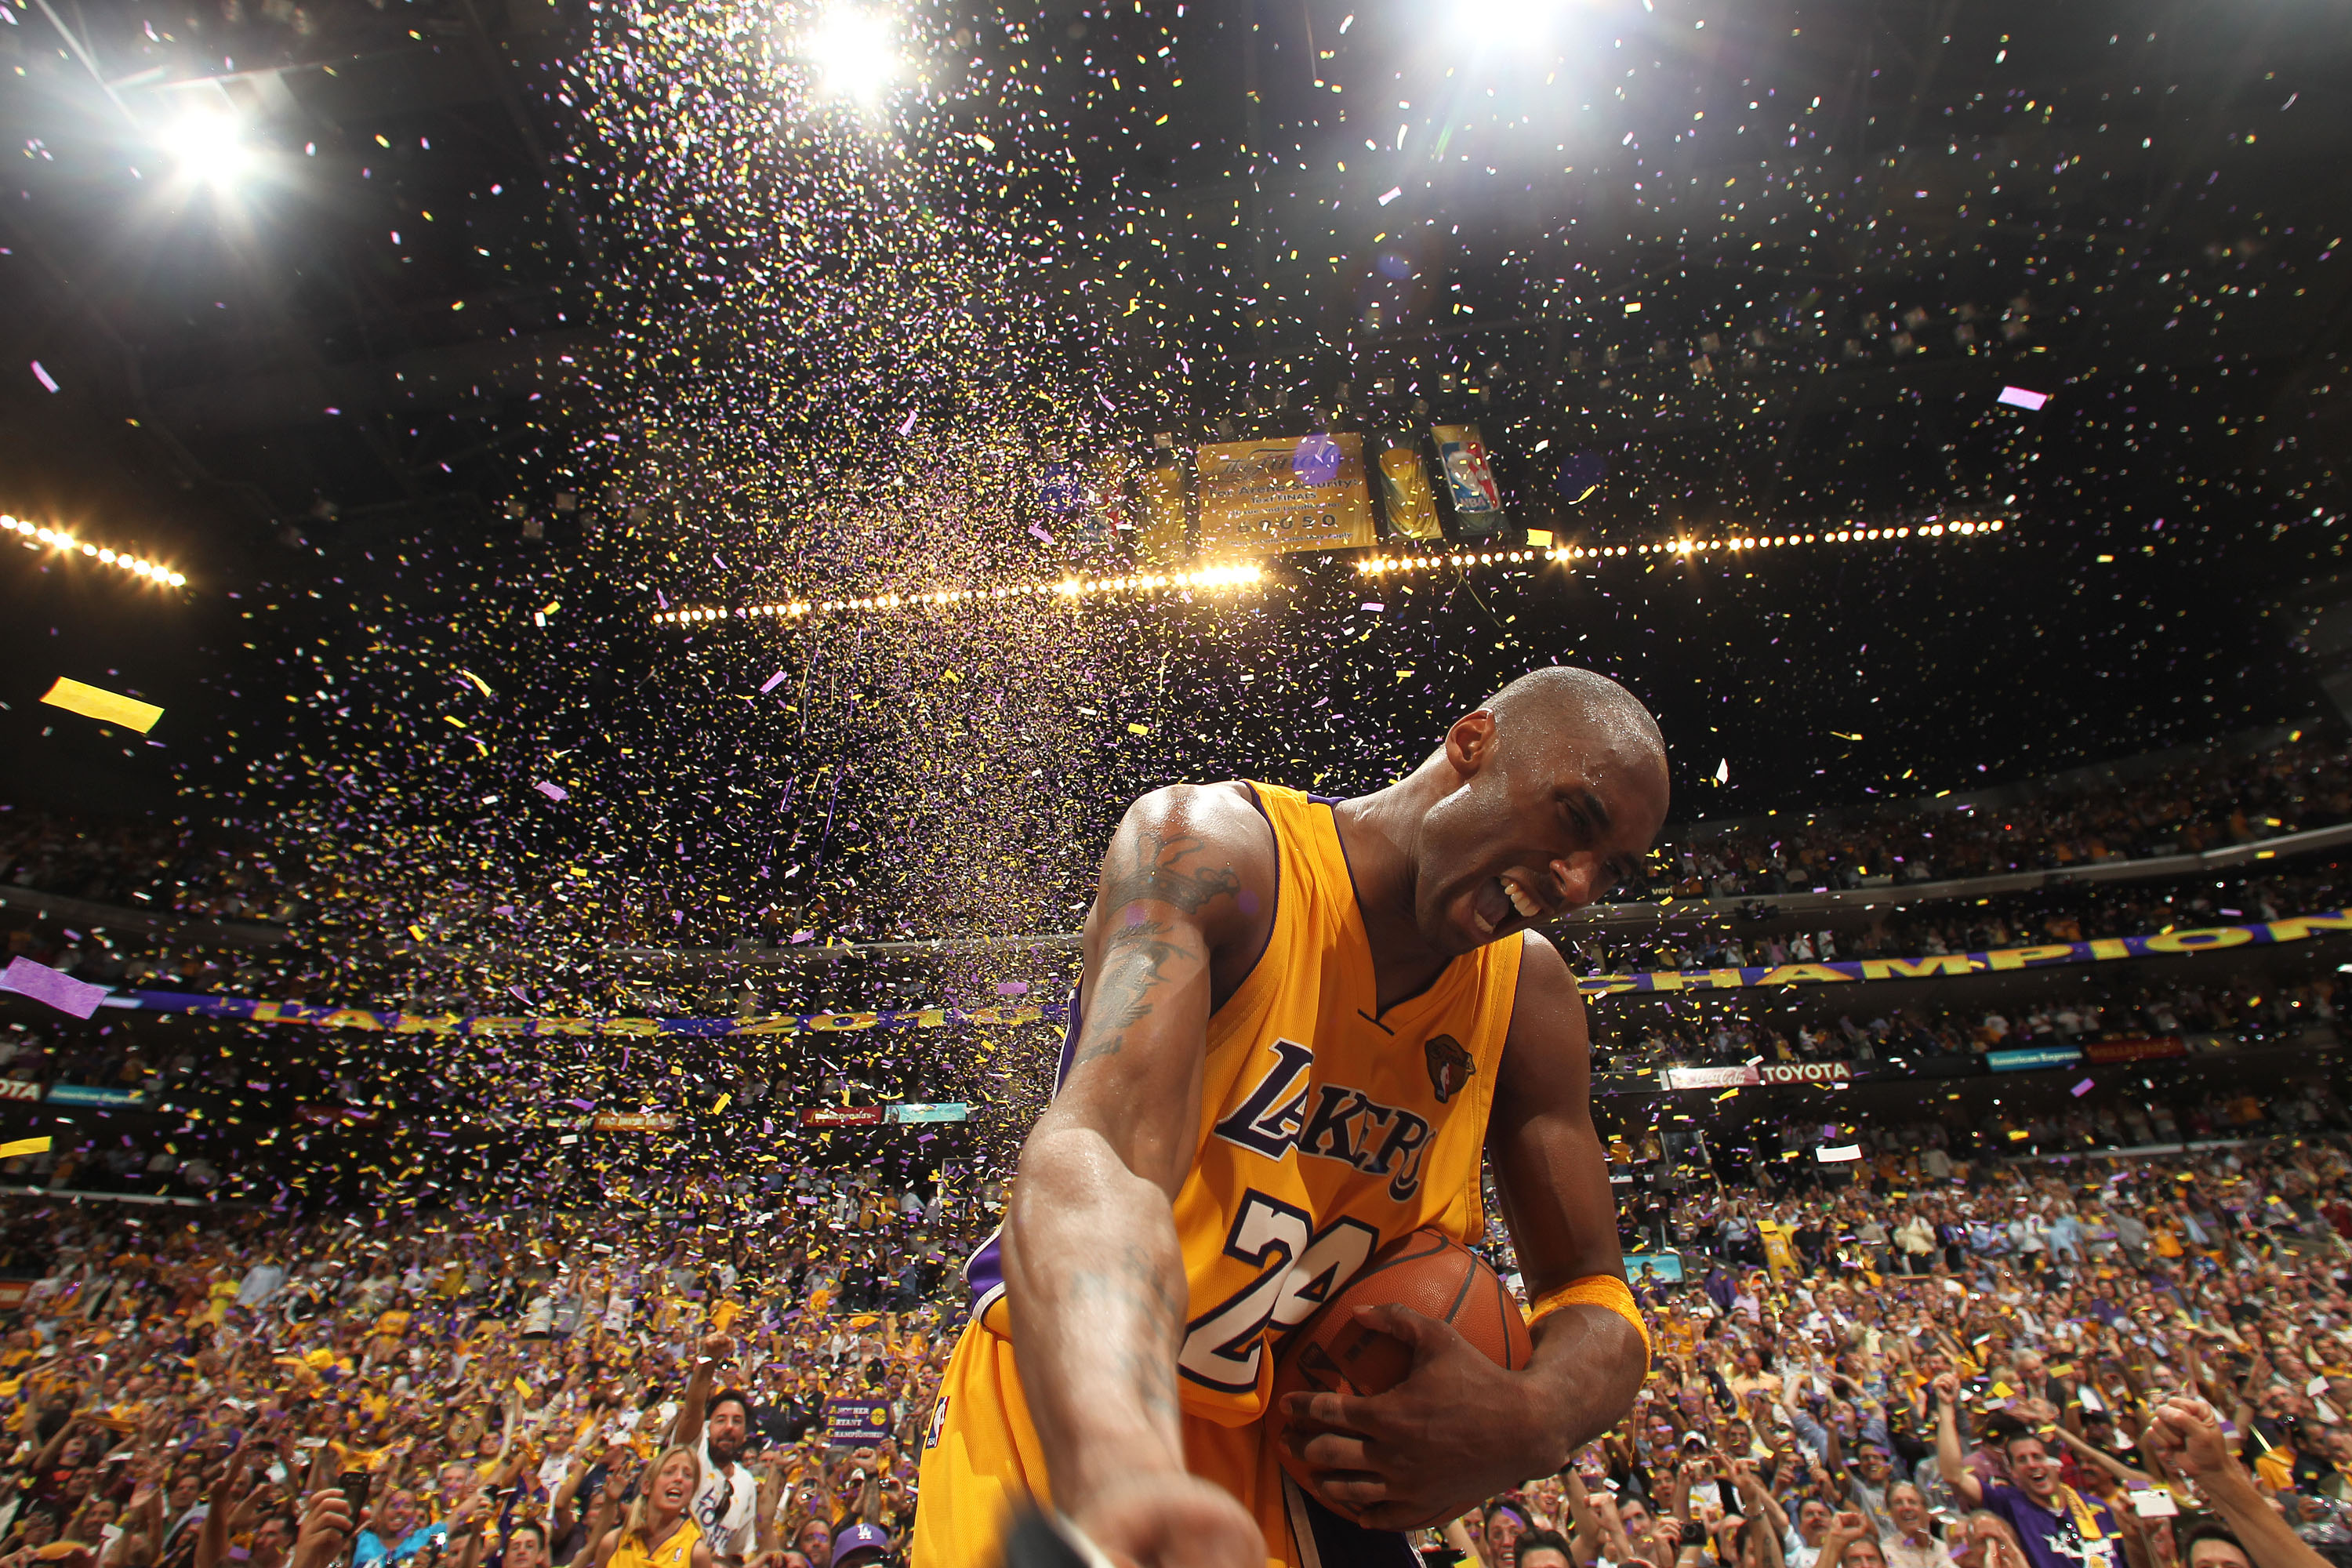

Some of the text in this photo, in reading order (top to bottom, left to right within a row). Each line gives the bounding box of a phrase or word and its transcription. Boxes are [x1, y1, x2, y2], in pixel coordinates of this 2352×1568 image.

[1208, 477, 1358, 498] For Arena Security:
[1250, 492, 1317, 505] Text FINALS
[1762, 1063, 1850, 1082] TOYOTA
[1214, 1037, 1436, 1203] LAKERS
[1178, 1187, 1380, 1395] 24
[858, 1523, 873, 1540] LA
